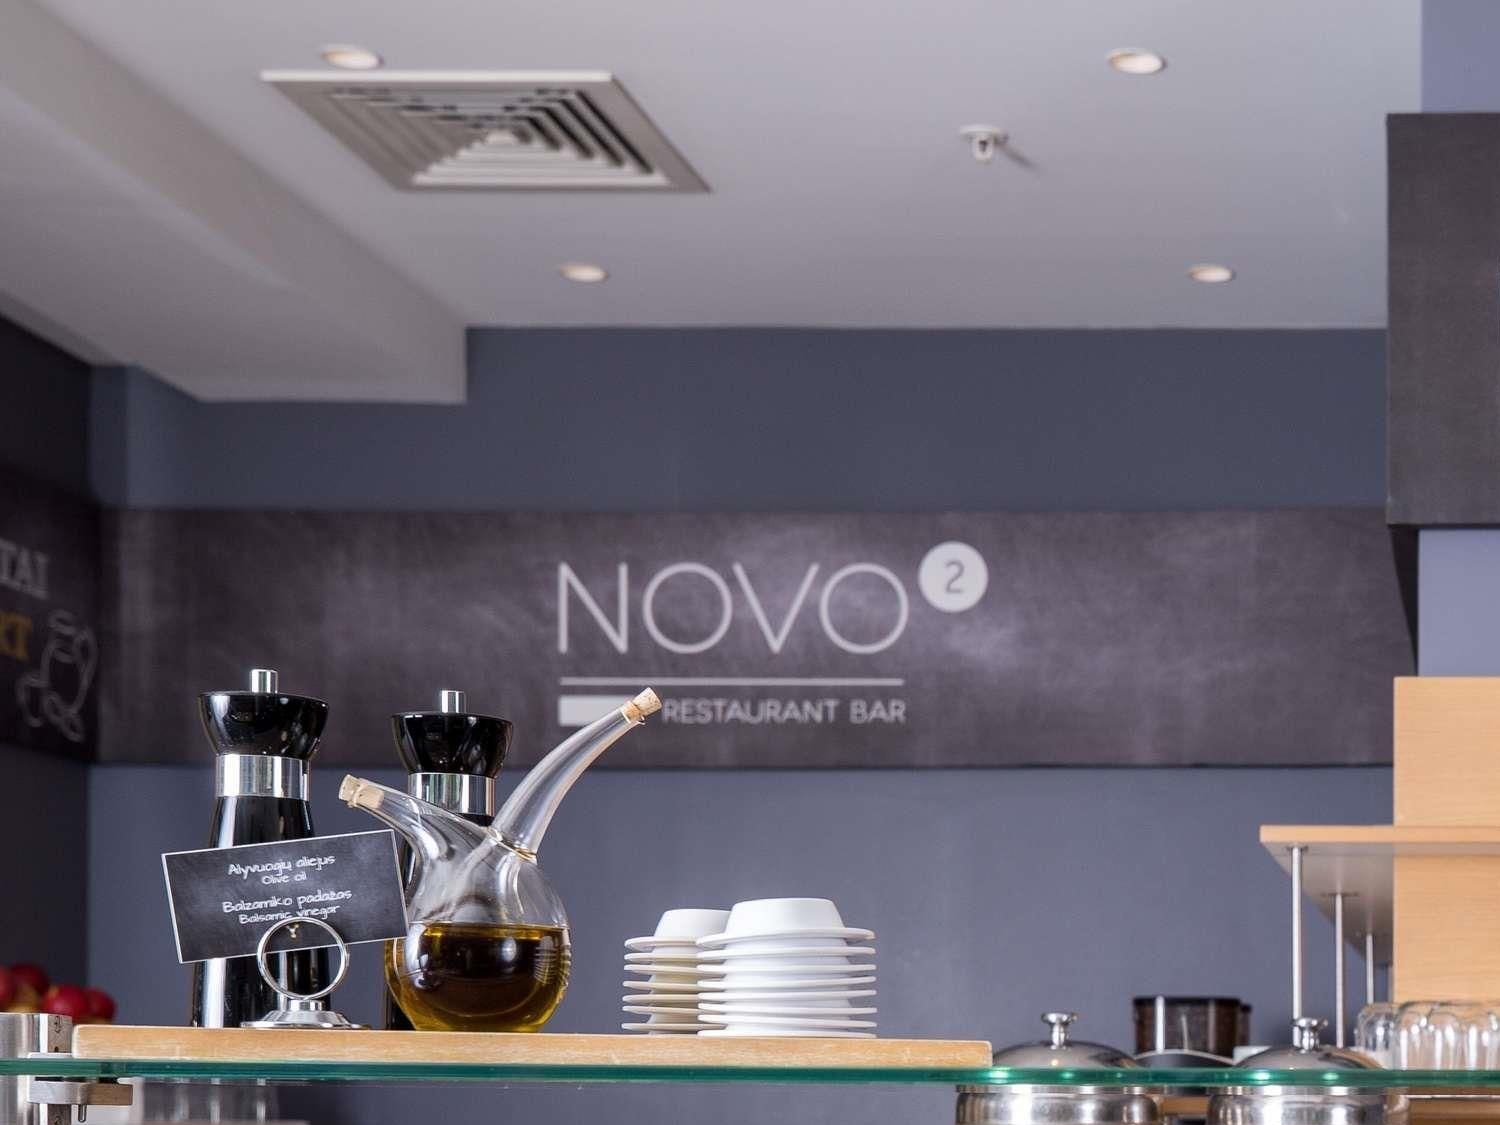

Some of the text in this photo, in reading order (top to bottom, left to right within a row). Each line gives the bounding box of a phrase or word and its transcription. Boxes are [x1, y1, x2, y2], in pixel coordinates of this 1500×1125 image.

[558, 561, 909, 655] NOVO
[662, 698, 906, 725] RESTAURANT BAR
[296, 855, 336, 871] aliejus
[261, 871, 307, 885] Olive oil
[222, 896, 293, 913] Balzamiko
[238, 904, 341, 925] Balsamic vinegar
